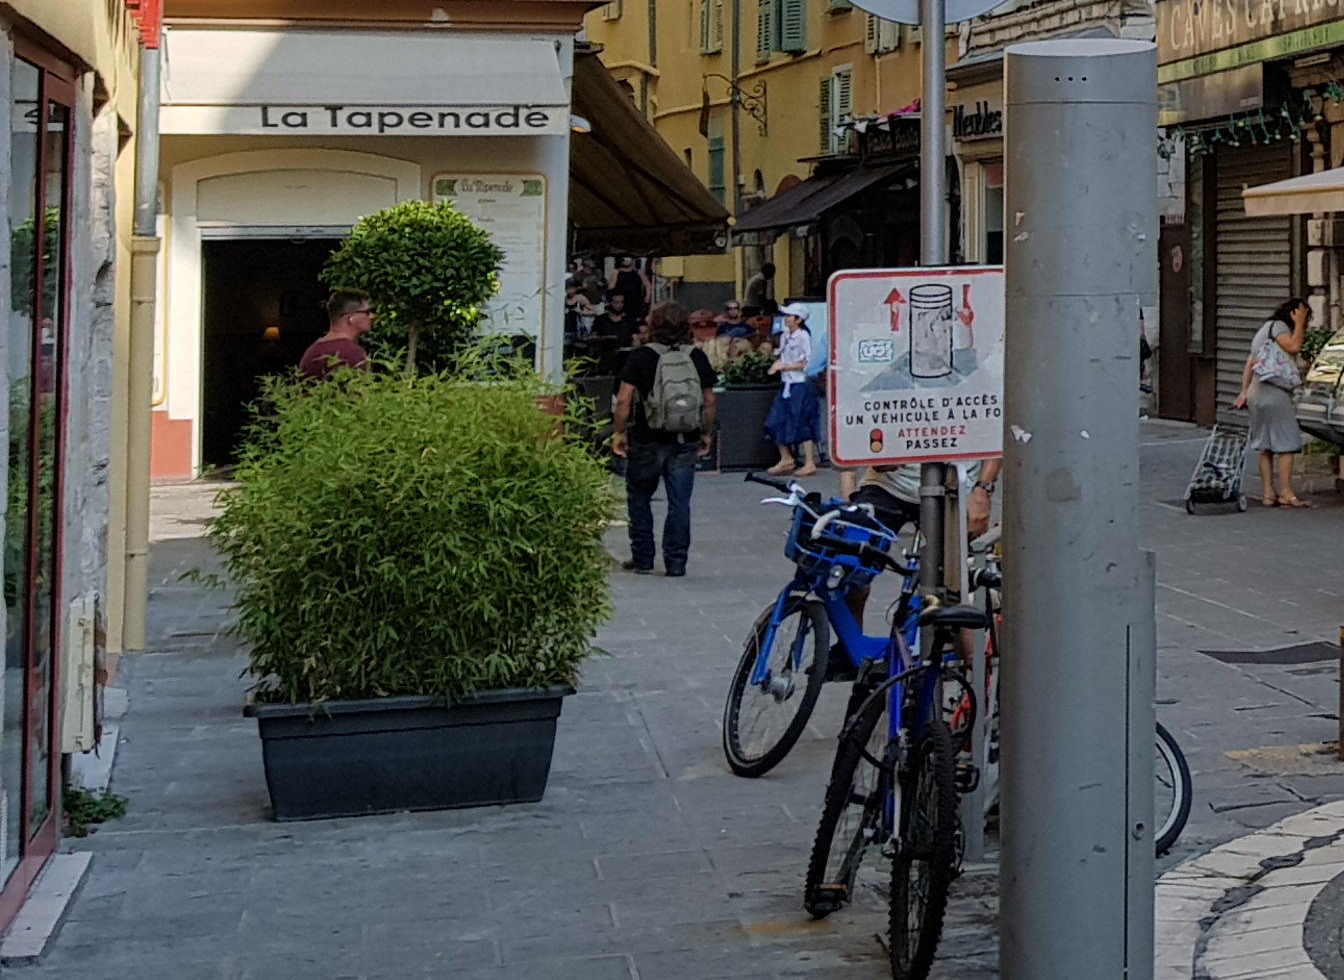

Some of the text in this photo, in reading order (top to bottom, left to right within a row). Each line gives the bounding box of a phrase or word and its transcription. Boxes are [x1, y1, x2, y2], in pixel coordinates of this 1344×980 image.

[261, 105, 550, 133] La Tapenade
[953, 101, 1003, 137] Meubles
[864, 394, 998, 412] CONTRÔLE D'ACCÈS
[846, 415, 864, 425] UN
[872, 411, 939, 424] VÉHICULE
[963, 409, 978, 420] LA
[986, 407, 1001, 418] FO
[898, 426, 967, 438] ATTENDEZ
[906, 438, 958, 450] PASSEZ
